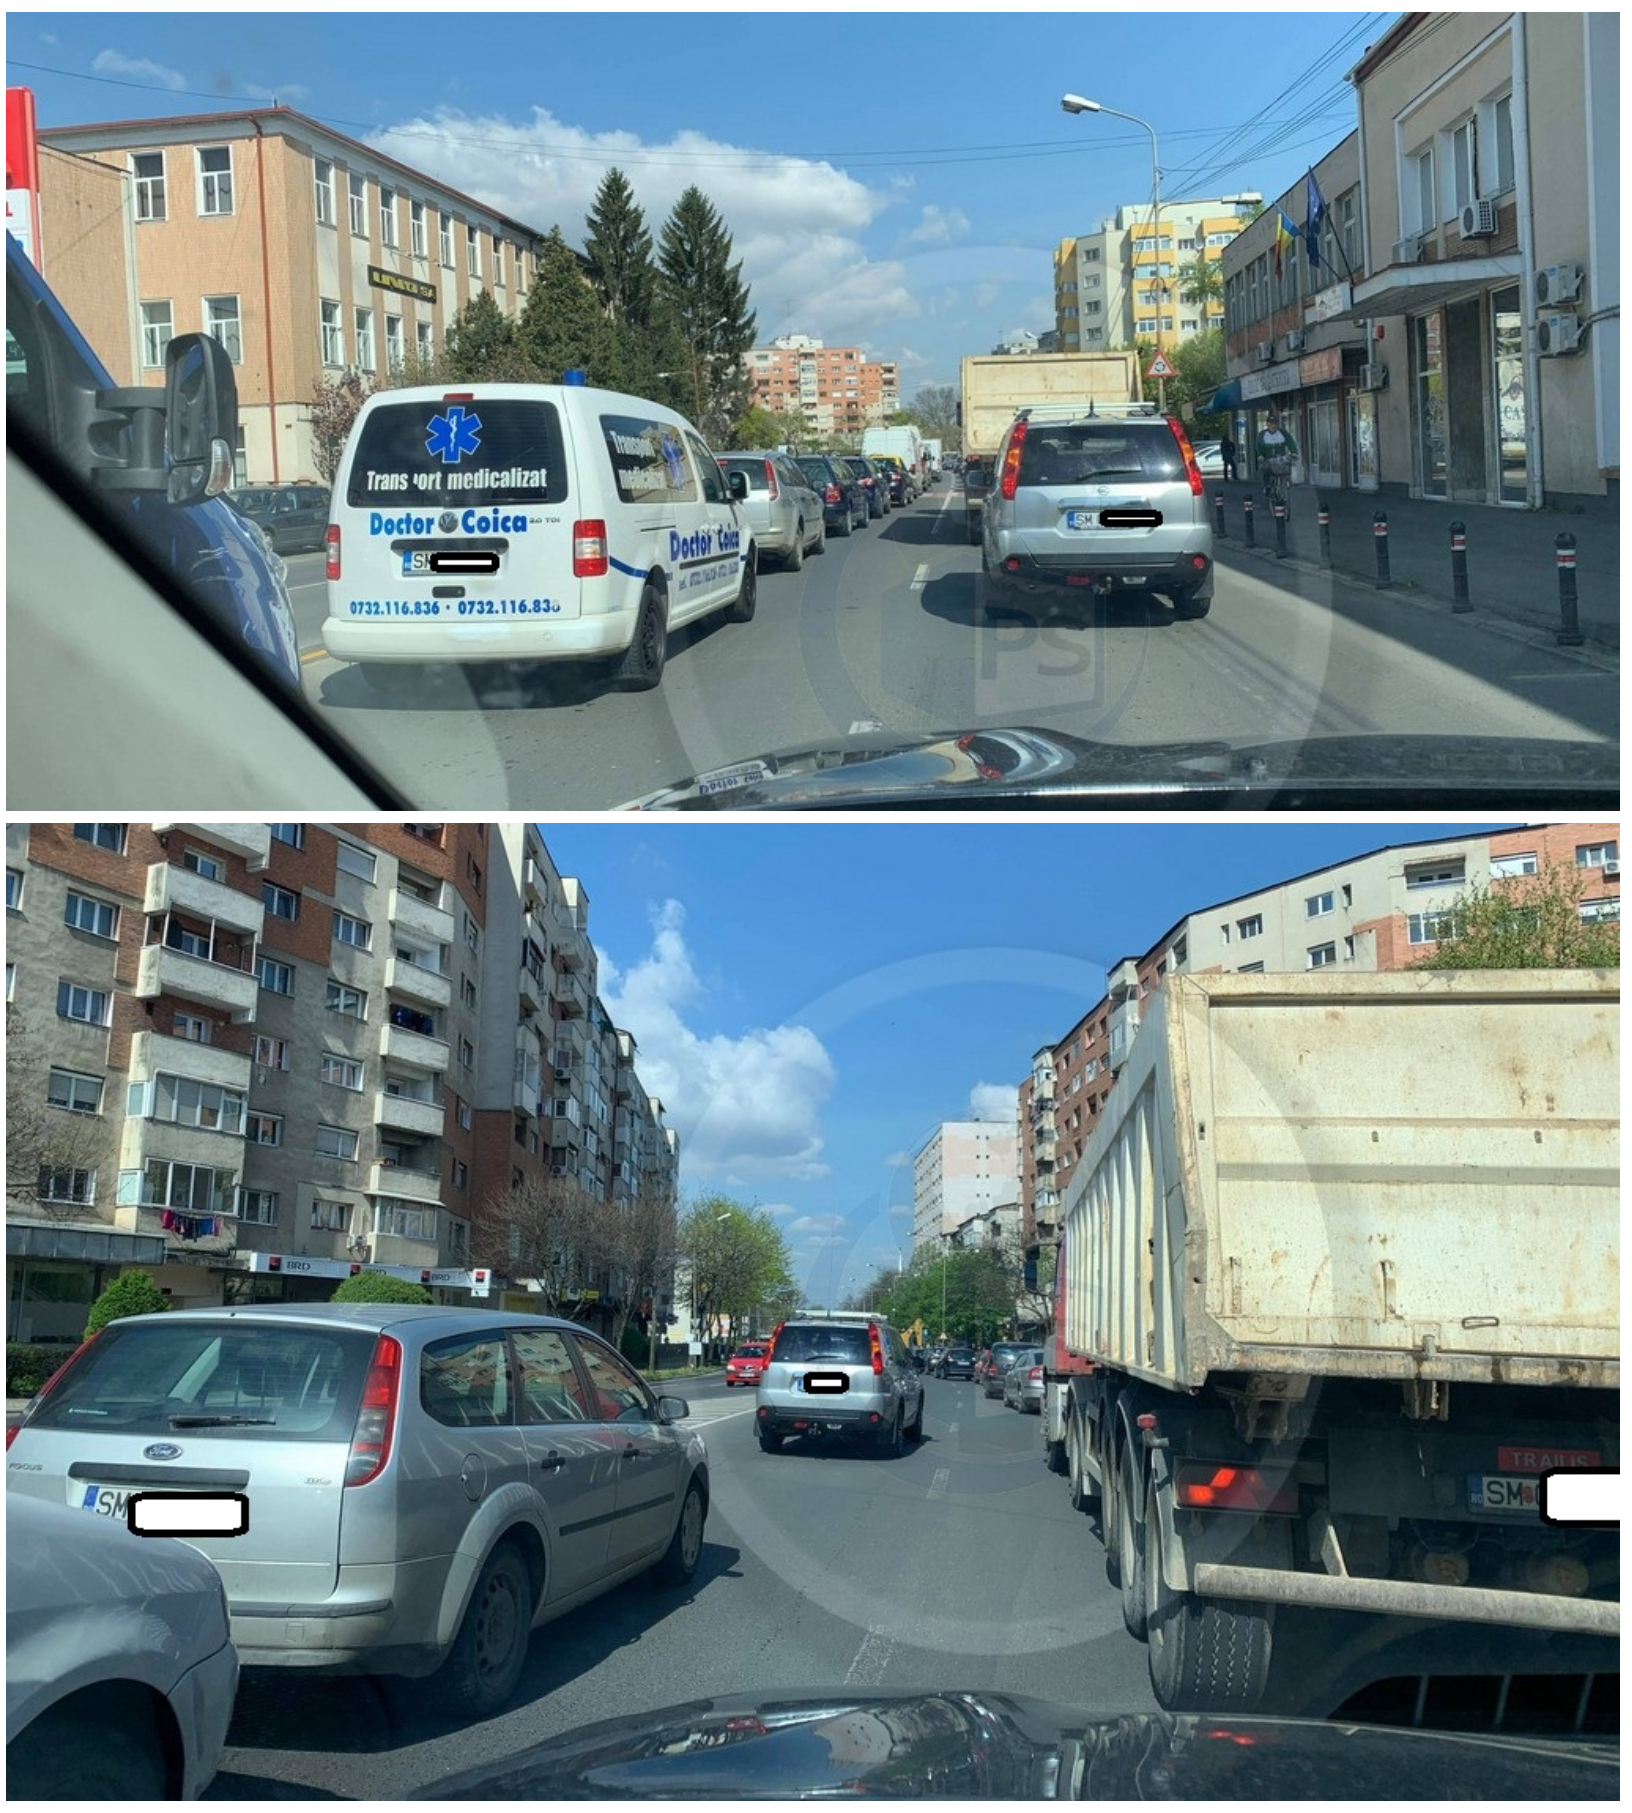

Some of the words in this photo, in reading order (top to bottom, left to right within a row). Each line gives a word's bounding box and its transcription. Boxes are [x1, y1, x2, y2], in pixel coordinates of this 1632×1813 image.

[447, 466, 548, 490] medicalizat
[370, 511, 435, 536] Doctor
[461, 507, 528, 534] Coica
[669, 529, 713, 562] Doctor
[350, 600, 440, 616] 0732.116.836
[286, 1261, 311, 1271] BRD
[431, 1272, 450, 1281] BRD
[9, 1463, 43, 1471] FOCUS
[96, 1491, 131, 1518] SM
[1486, 1480, 1523, 1506] SM
